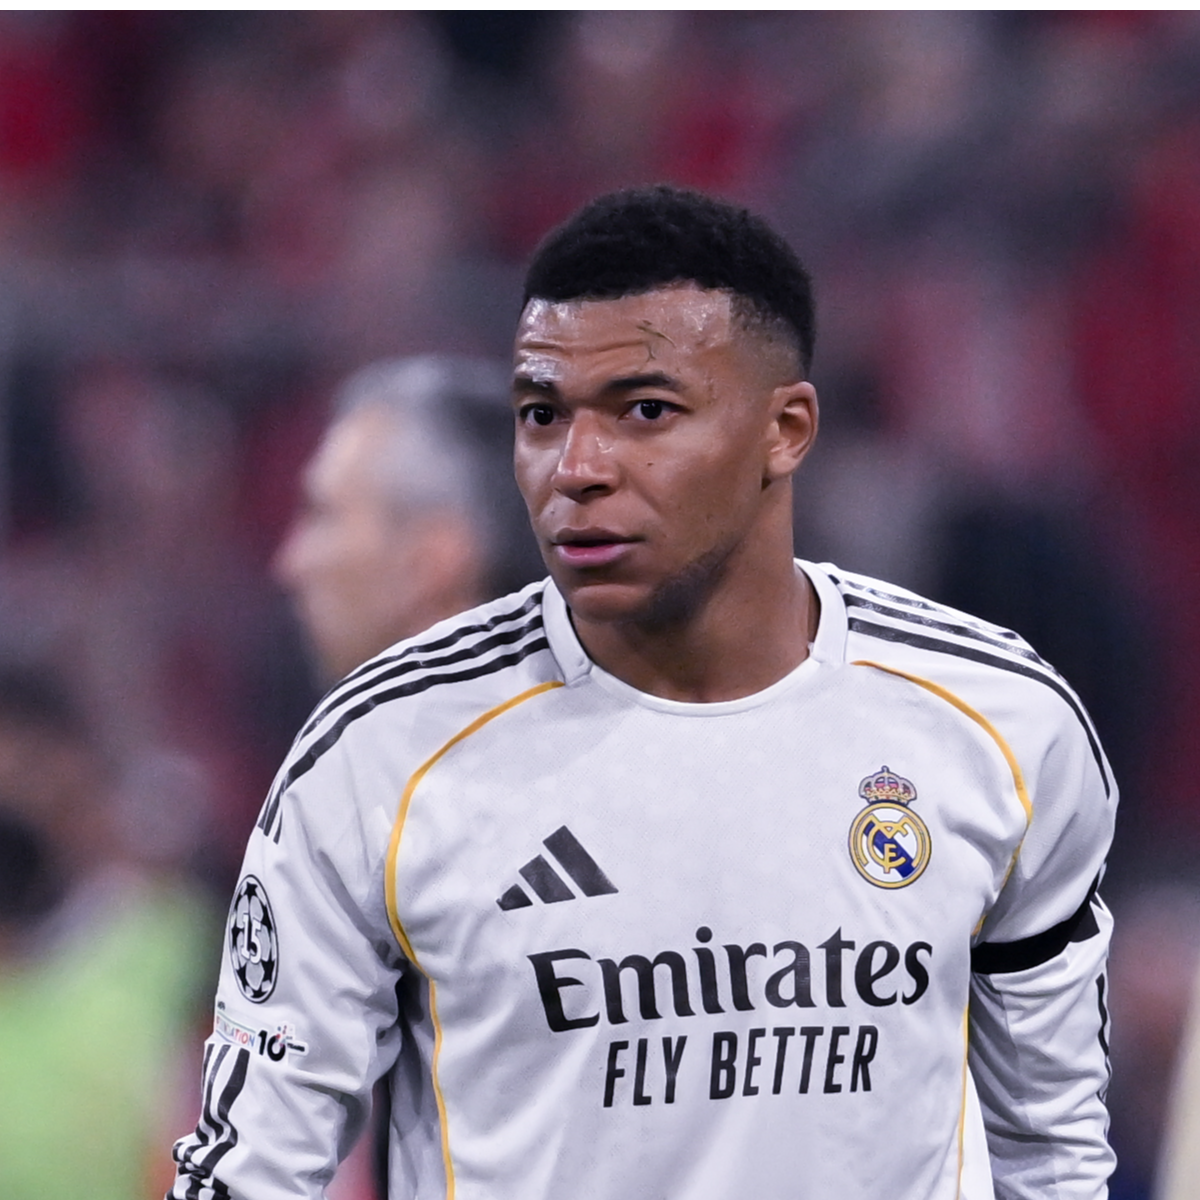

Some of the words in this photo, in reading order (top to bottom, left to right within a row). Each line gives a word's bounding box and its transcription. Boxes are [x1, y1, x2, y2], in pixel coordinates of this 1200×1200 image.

[241, 911, 262, 965] 15
[526, 925, 933, 1032] Emirates
[603, 1035, 688, 1107] FLY
[709, 1024, 878, 1100] BETTER
